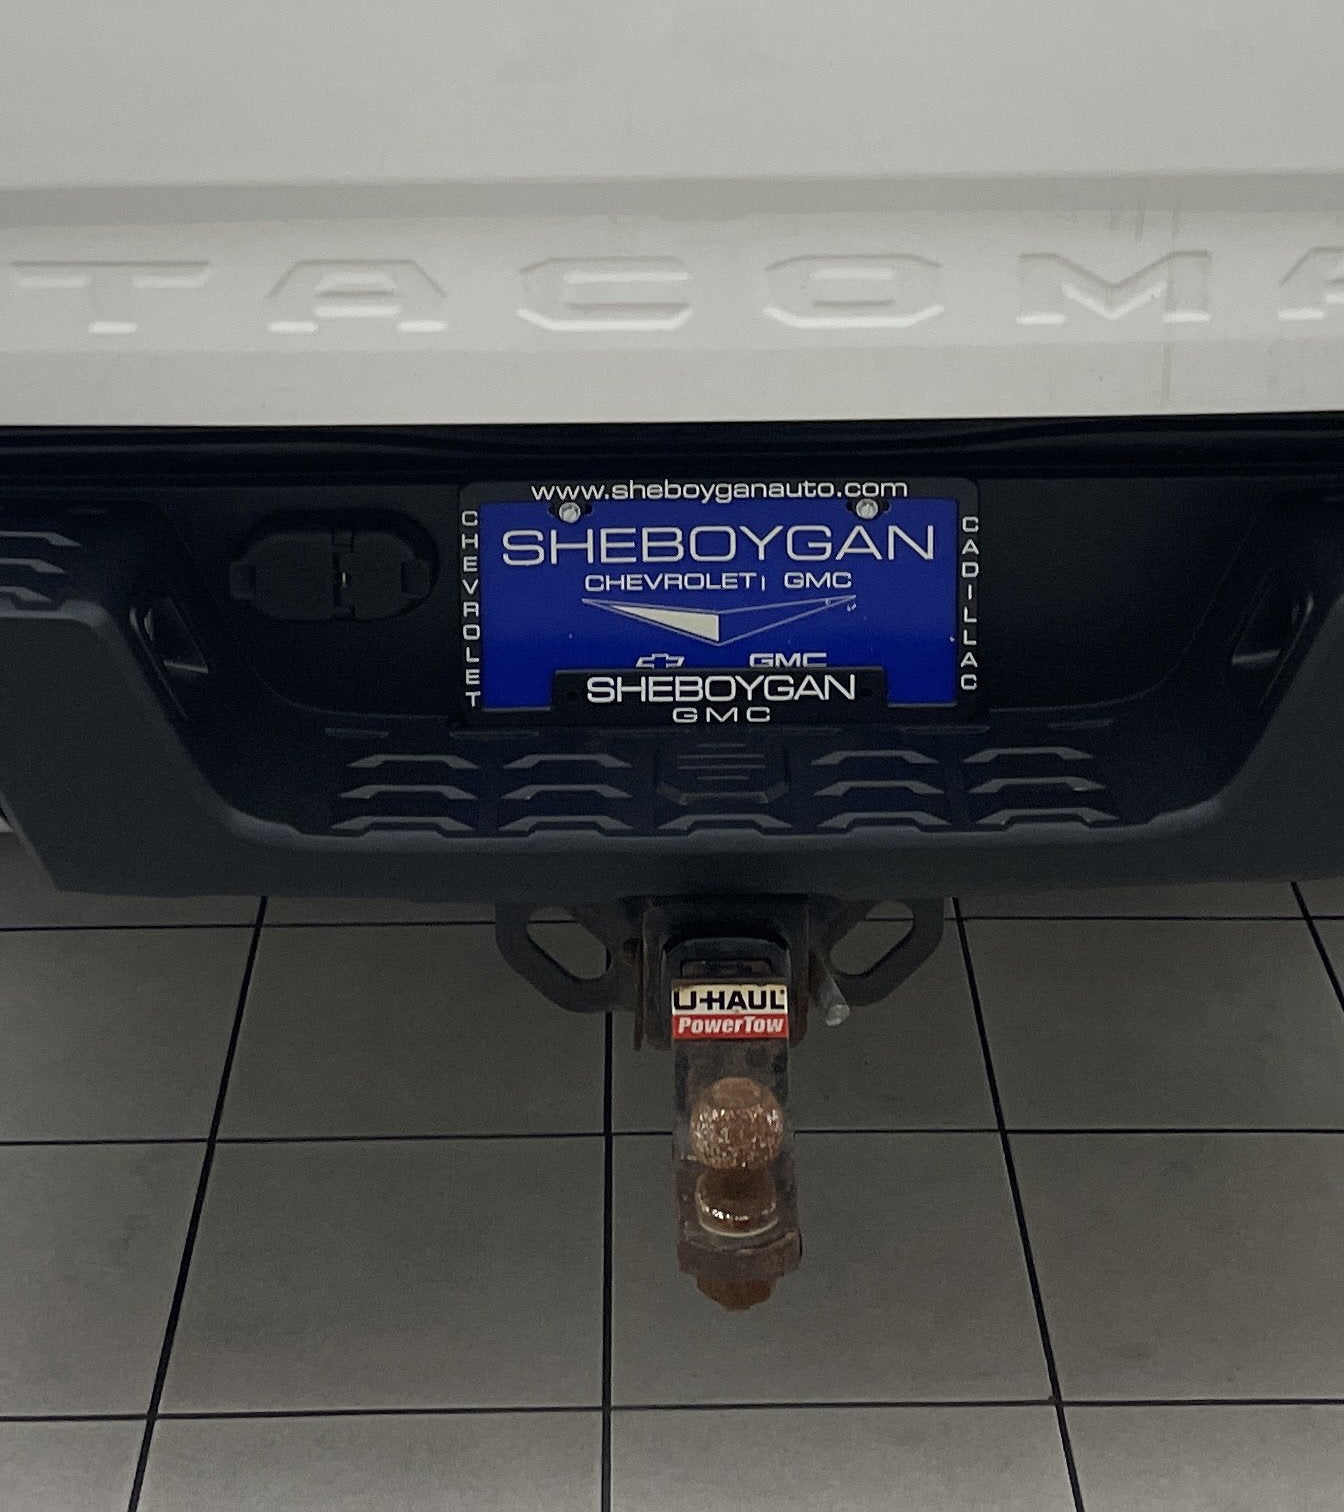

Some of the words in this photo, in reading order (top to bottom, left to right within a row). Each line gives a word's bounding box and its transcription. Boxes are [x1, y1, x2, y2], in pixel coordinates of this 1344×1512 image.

[531, 479, 908, 504] www.sheboyganauto.com
[502, 524, 935, 566] SHEBOYGAN
[584, 572, 757, 592] CHEVROLET
[783, 571, 853, 589] GMC
[461, 510, 481, 708] CHEVROLET
[961, 516, 978, 691] CADILLAC
[749, 652, 828, 668] GMC
[586, 674, 856, 704] SHEBOYGAN
[672, 706, 771, 724] GMC
[673, 989, 785, 1011] U-HAUL
[677, 1015, 785, 1035] PowerTow
